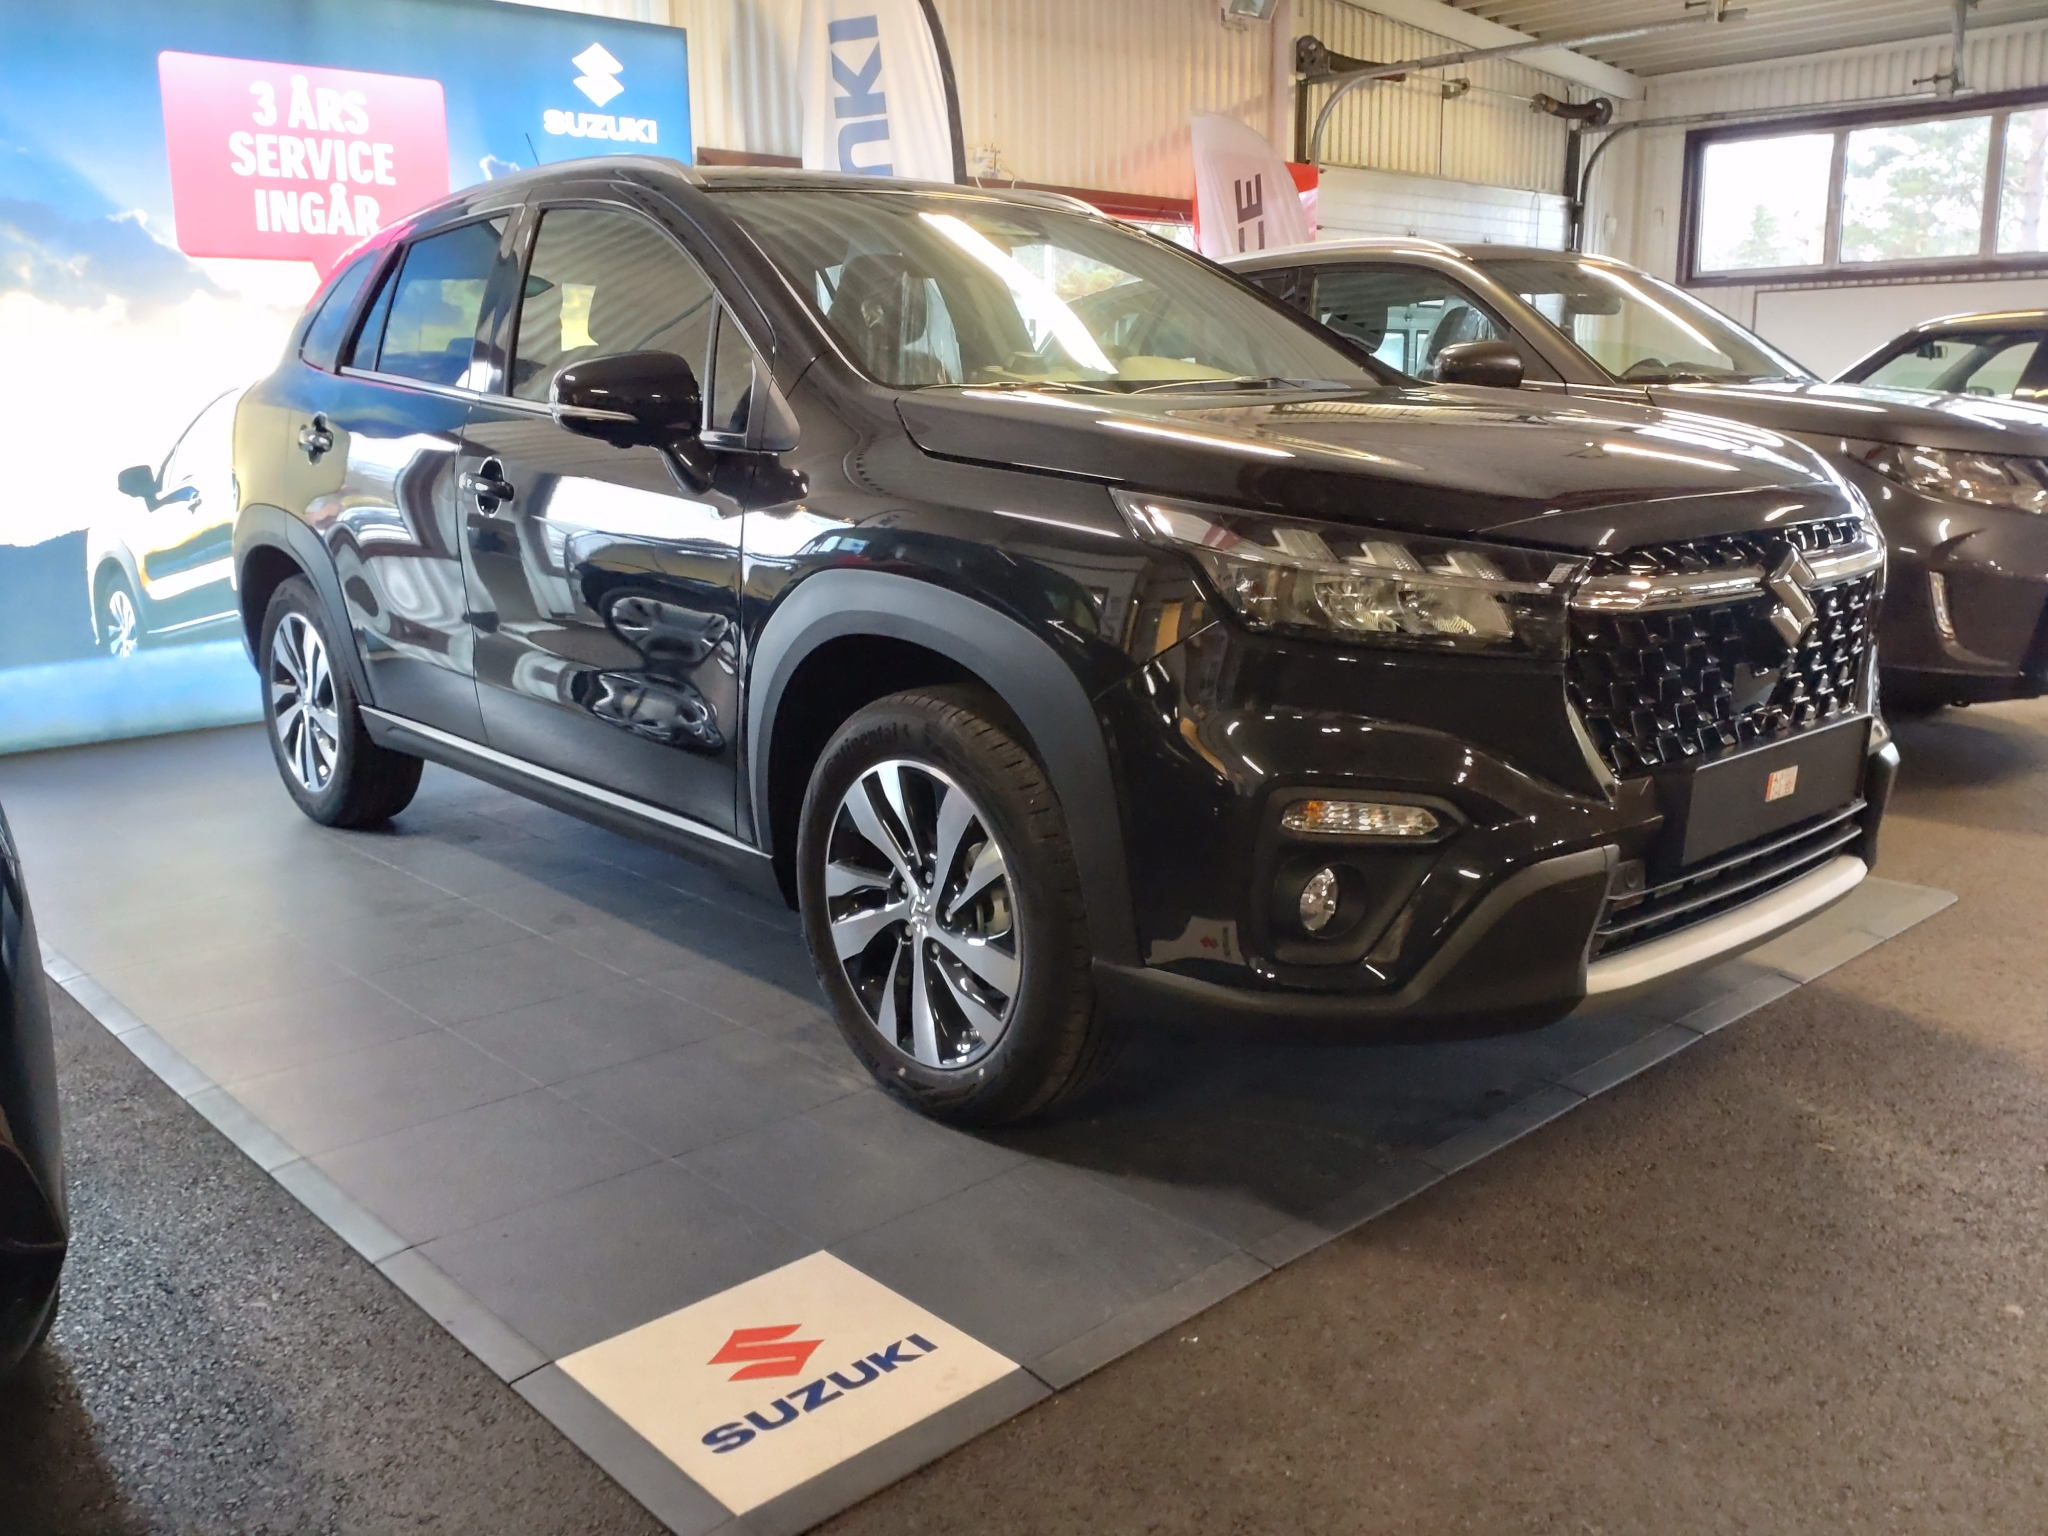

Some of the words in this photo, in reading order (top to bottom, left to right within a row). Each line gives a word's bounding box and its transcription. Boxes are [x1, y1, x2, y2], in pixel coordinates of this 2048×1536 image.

[250, 80, 278, 127] 3
[288, 74, 370, 135] ÅRS
[543, 109, 658, 144] SUZUKI
[229, 131, 396, 186] SERVICE
[254, 182, 380, 237] INGÅR
[701, 1333, 939, 1454] SUZUKI
